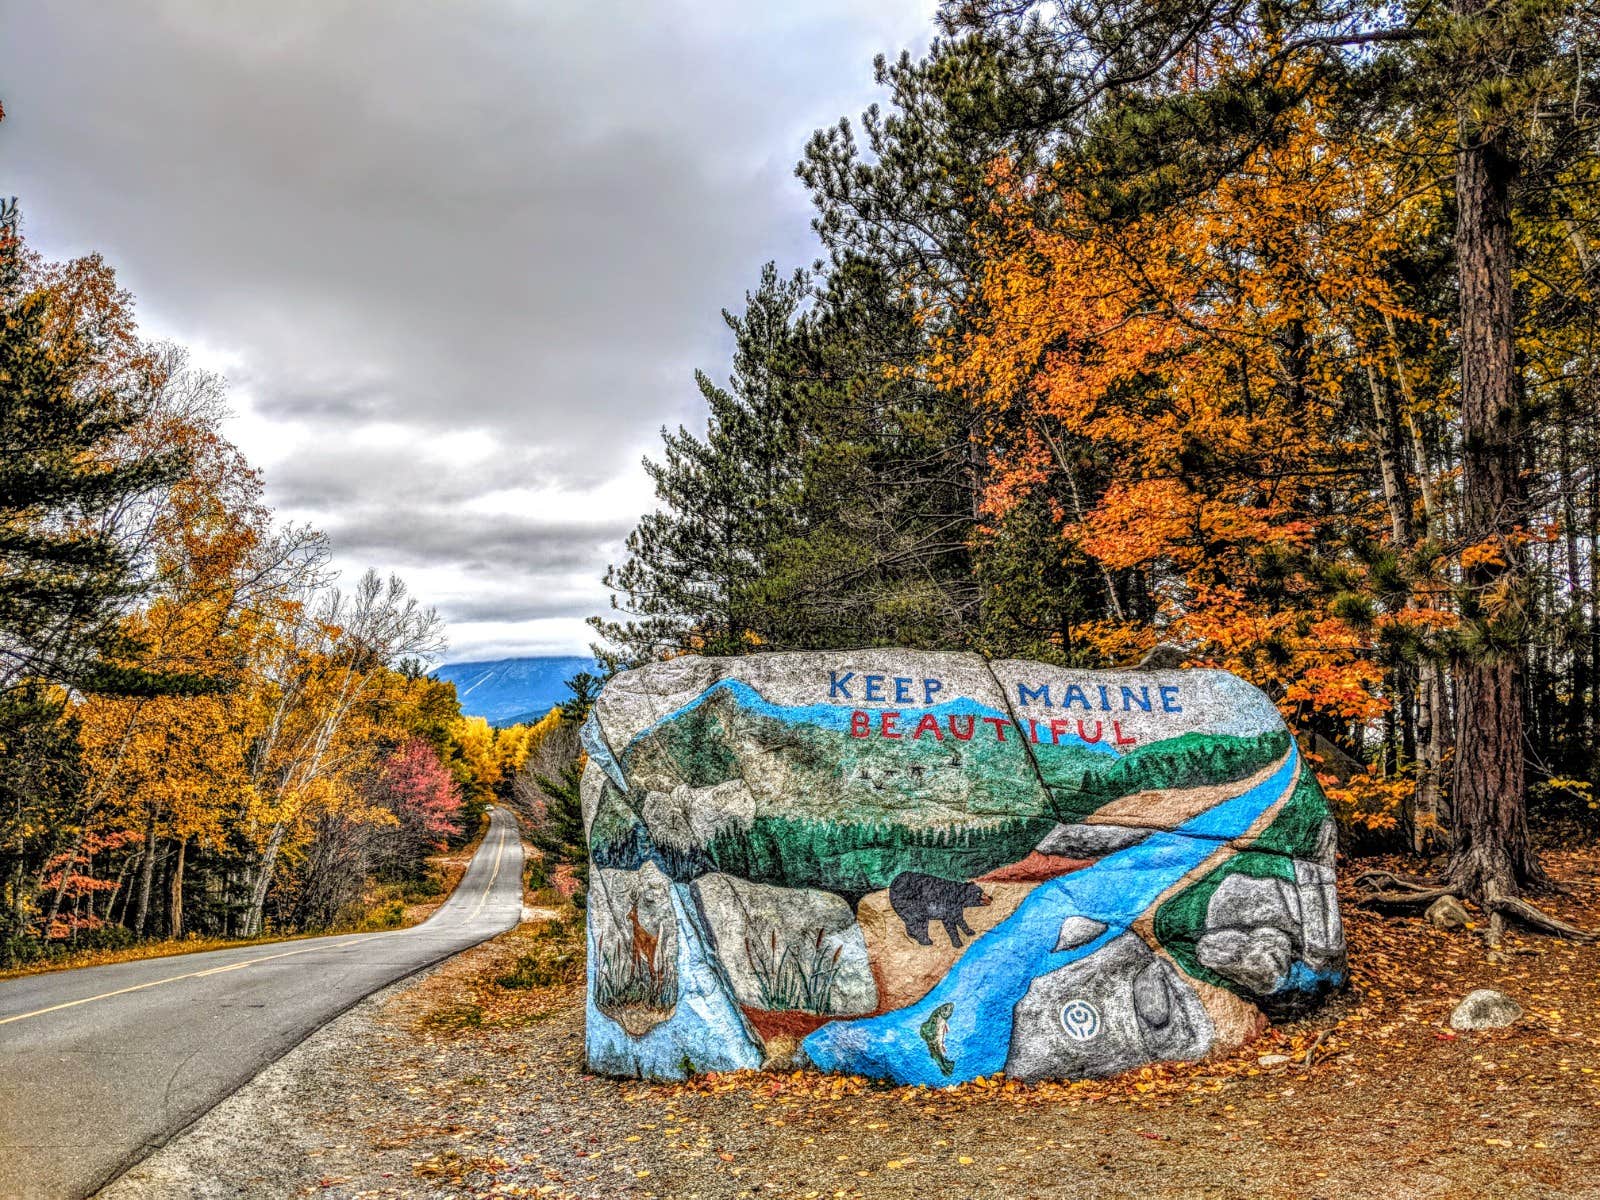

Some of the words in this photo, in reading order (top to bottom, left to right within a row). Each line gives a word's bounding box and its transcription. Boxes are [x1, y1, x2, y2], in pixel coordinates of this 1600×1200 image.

[829, 670, 943, 704] KEEP
[1017, 683, 1183, 713] MAINE
[850, 710, 1136, 745] BEAUTIFUL
